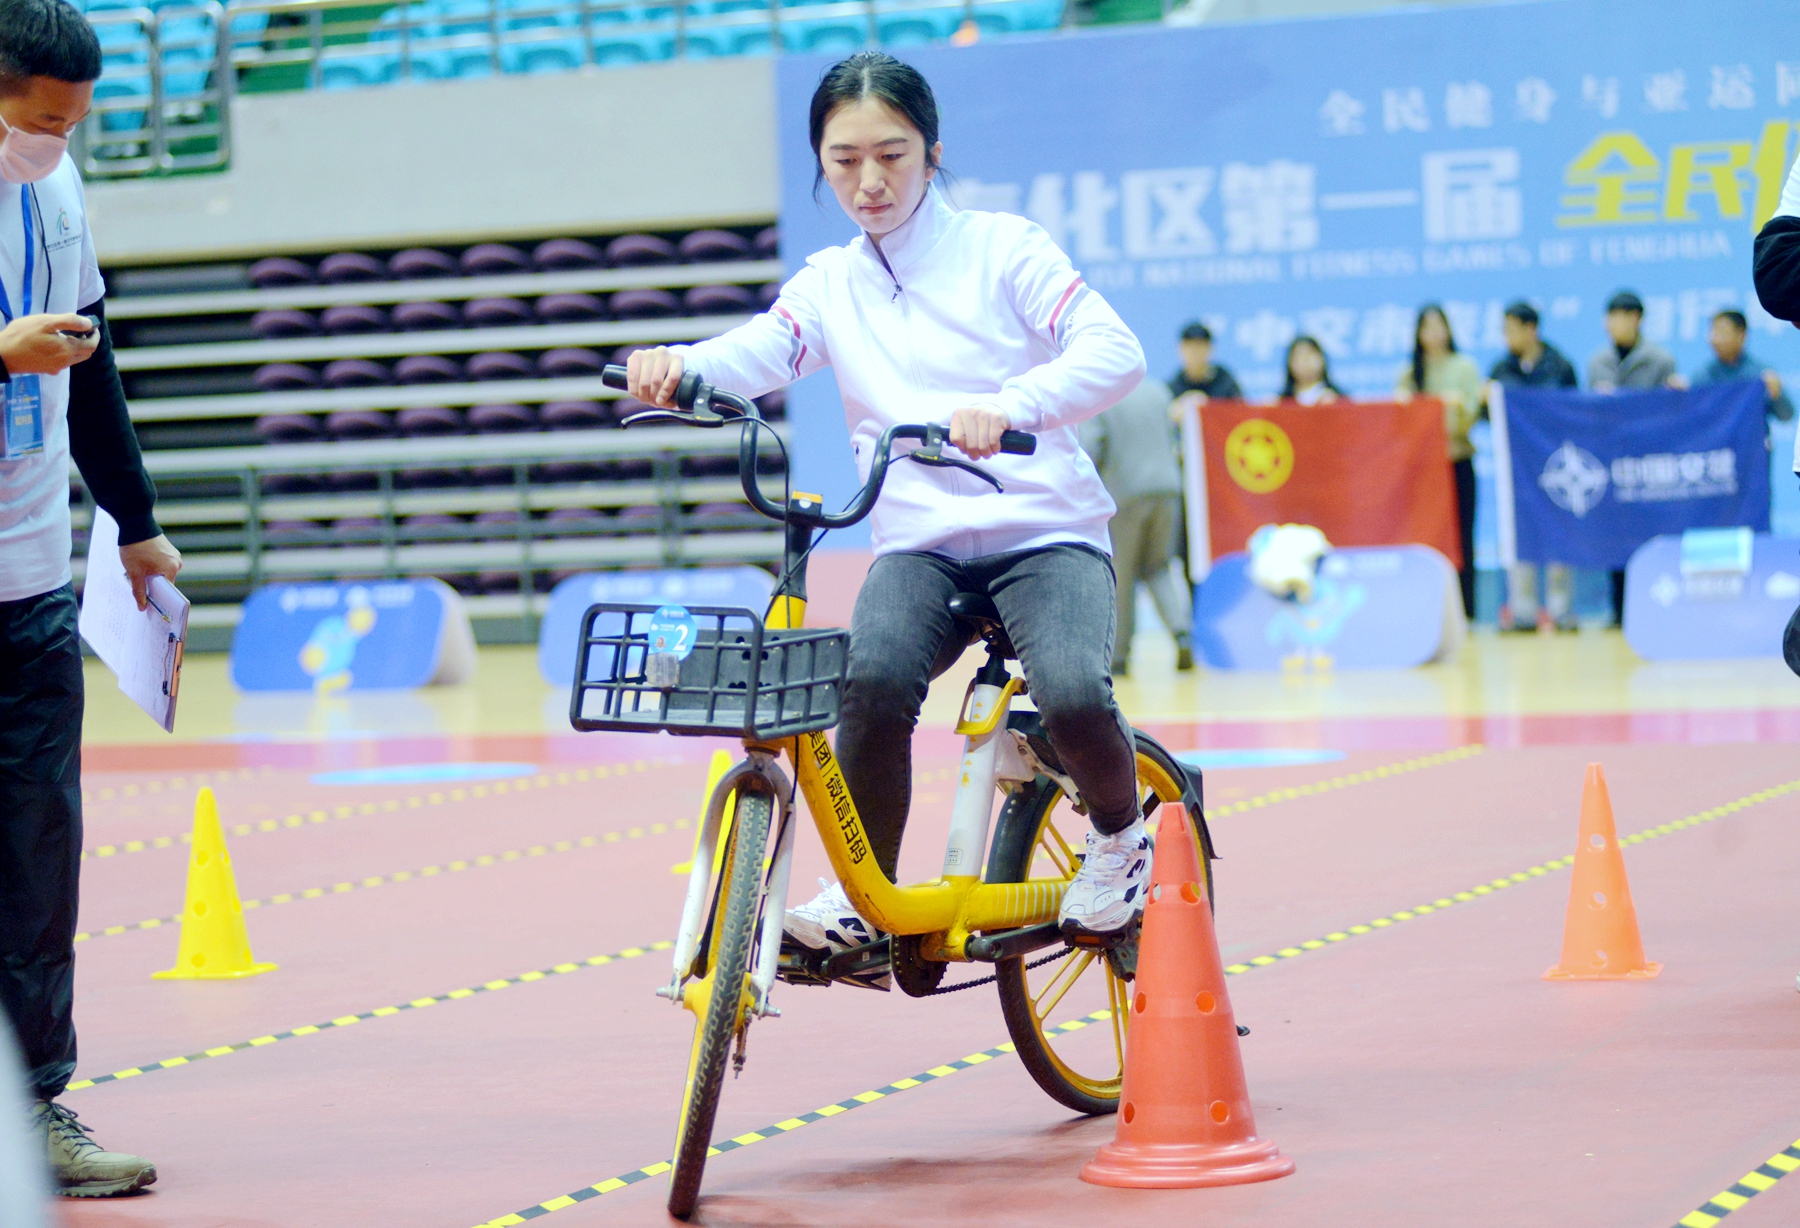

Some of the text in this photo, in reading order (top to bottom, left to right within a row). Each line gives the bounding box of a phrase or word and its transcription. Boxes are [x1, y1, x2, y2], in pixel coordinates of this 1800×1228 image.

[945, 147, 1522, 262] 化区第一届
[1538, 237, 1575, 267] OF
[672, 624, 689, 651] 2
